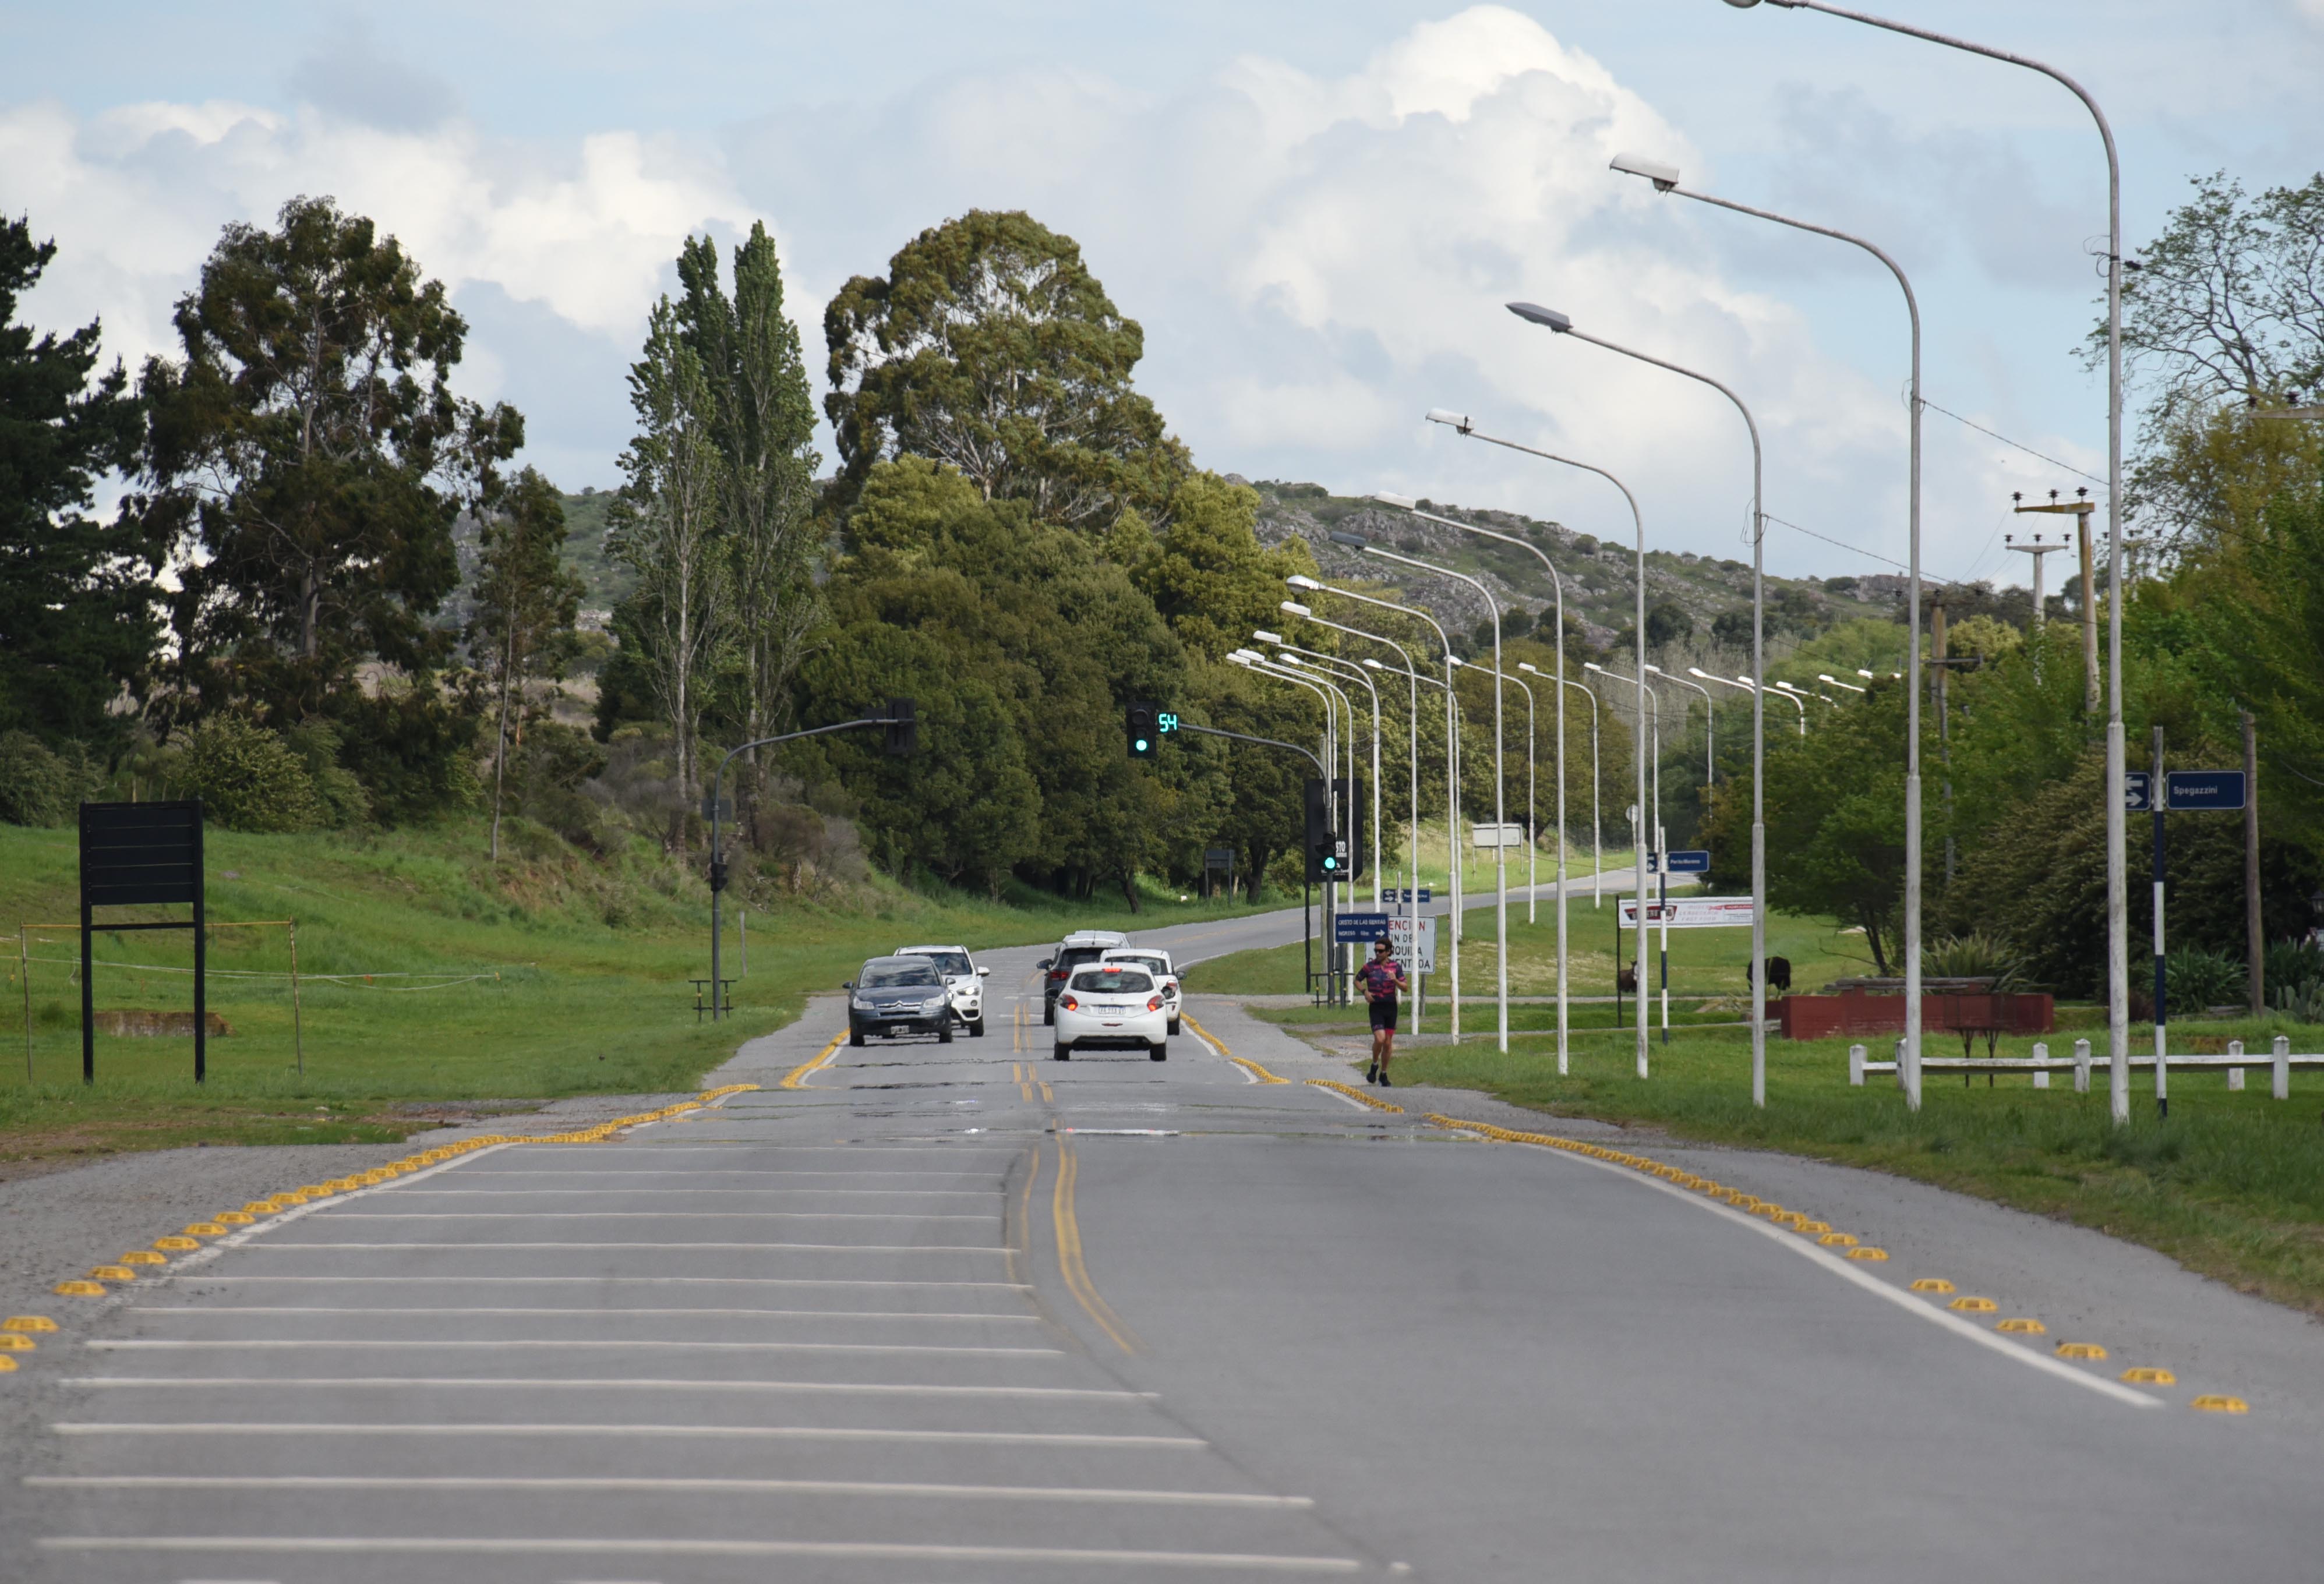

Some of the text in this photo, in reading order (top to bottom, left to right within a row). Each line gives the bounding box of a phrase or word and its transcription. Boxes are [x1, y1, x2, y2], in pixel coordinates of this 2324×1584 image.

[1159, 713, 1177, 732] 54
[2173, 786, 2218, 796] Spegazzini
[1389, 920, 1425, 931] ENCIN
[1389, 934, 1400, 942] IN
